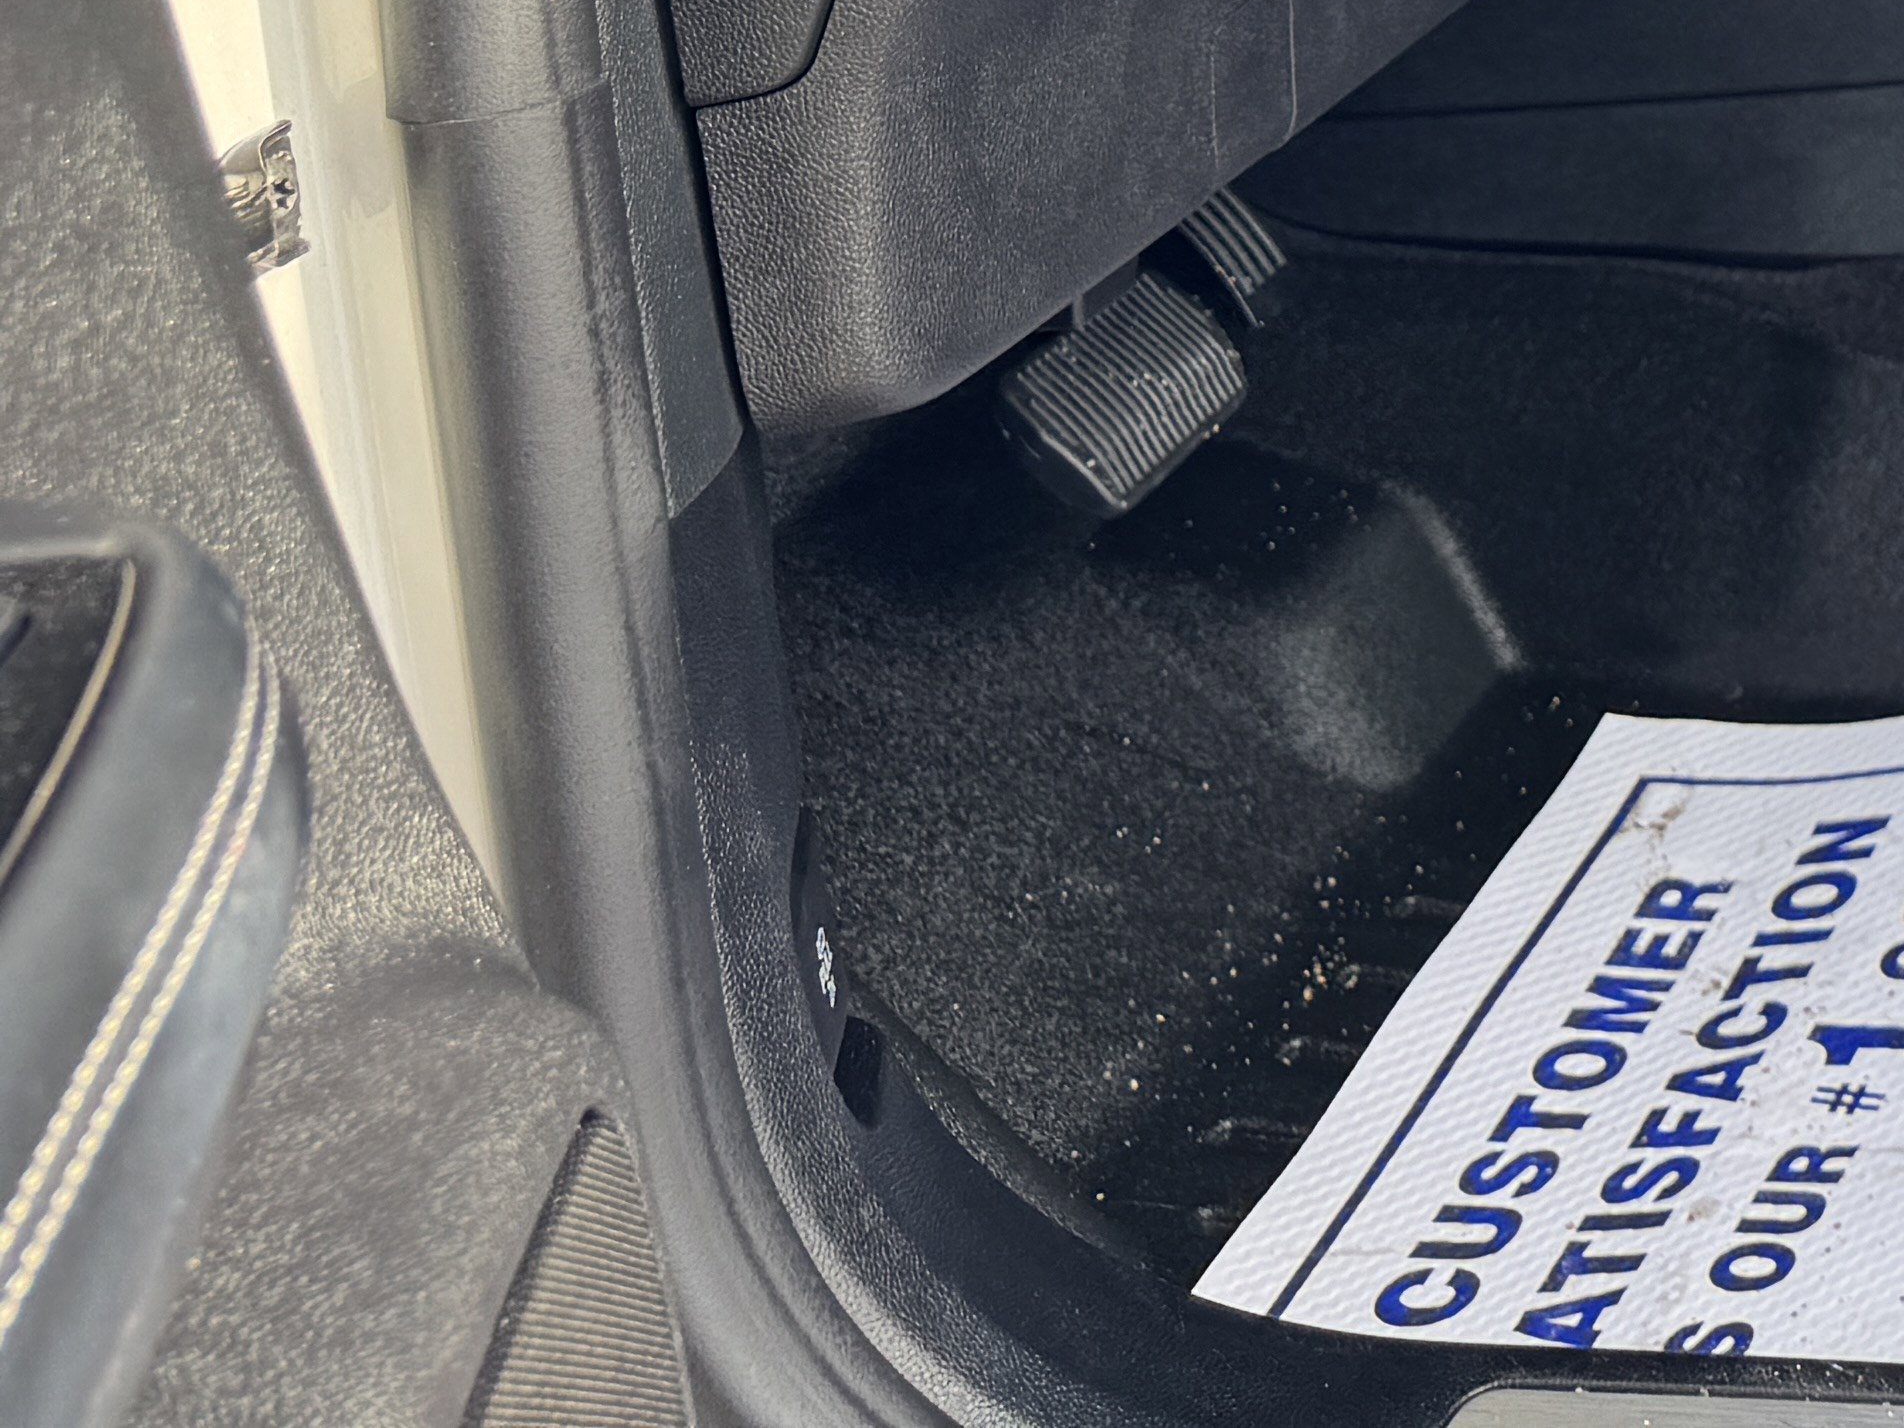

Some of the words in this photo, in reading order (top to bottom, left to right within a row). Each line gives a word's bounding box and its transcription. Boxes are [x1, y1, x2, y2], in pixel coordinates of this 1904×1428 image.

[1374, 877, 1738, 1328] CUSTOMER
[1512, 813, 1894, 1351] ATISFACTION
[1708, 1144, 1862, 1293] OUR
